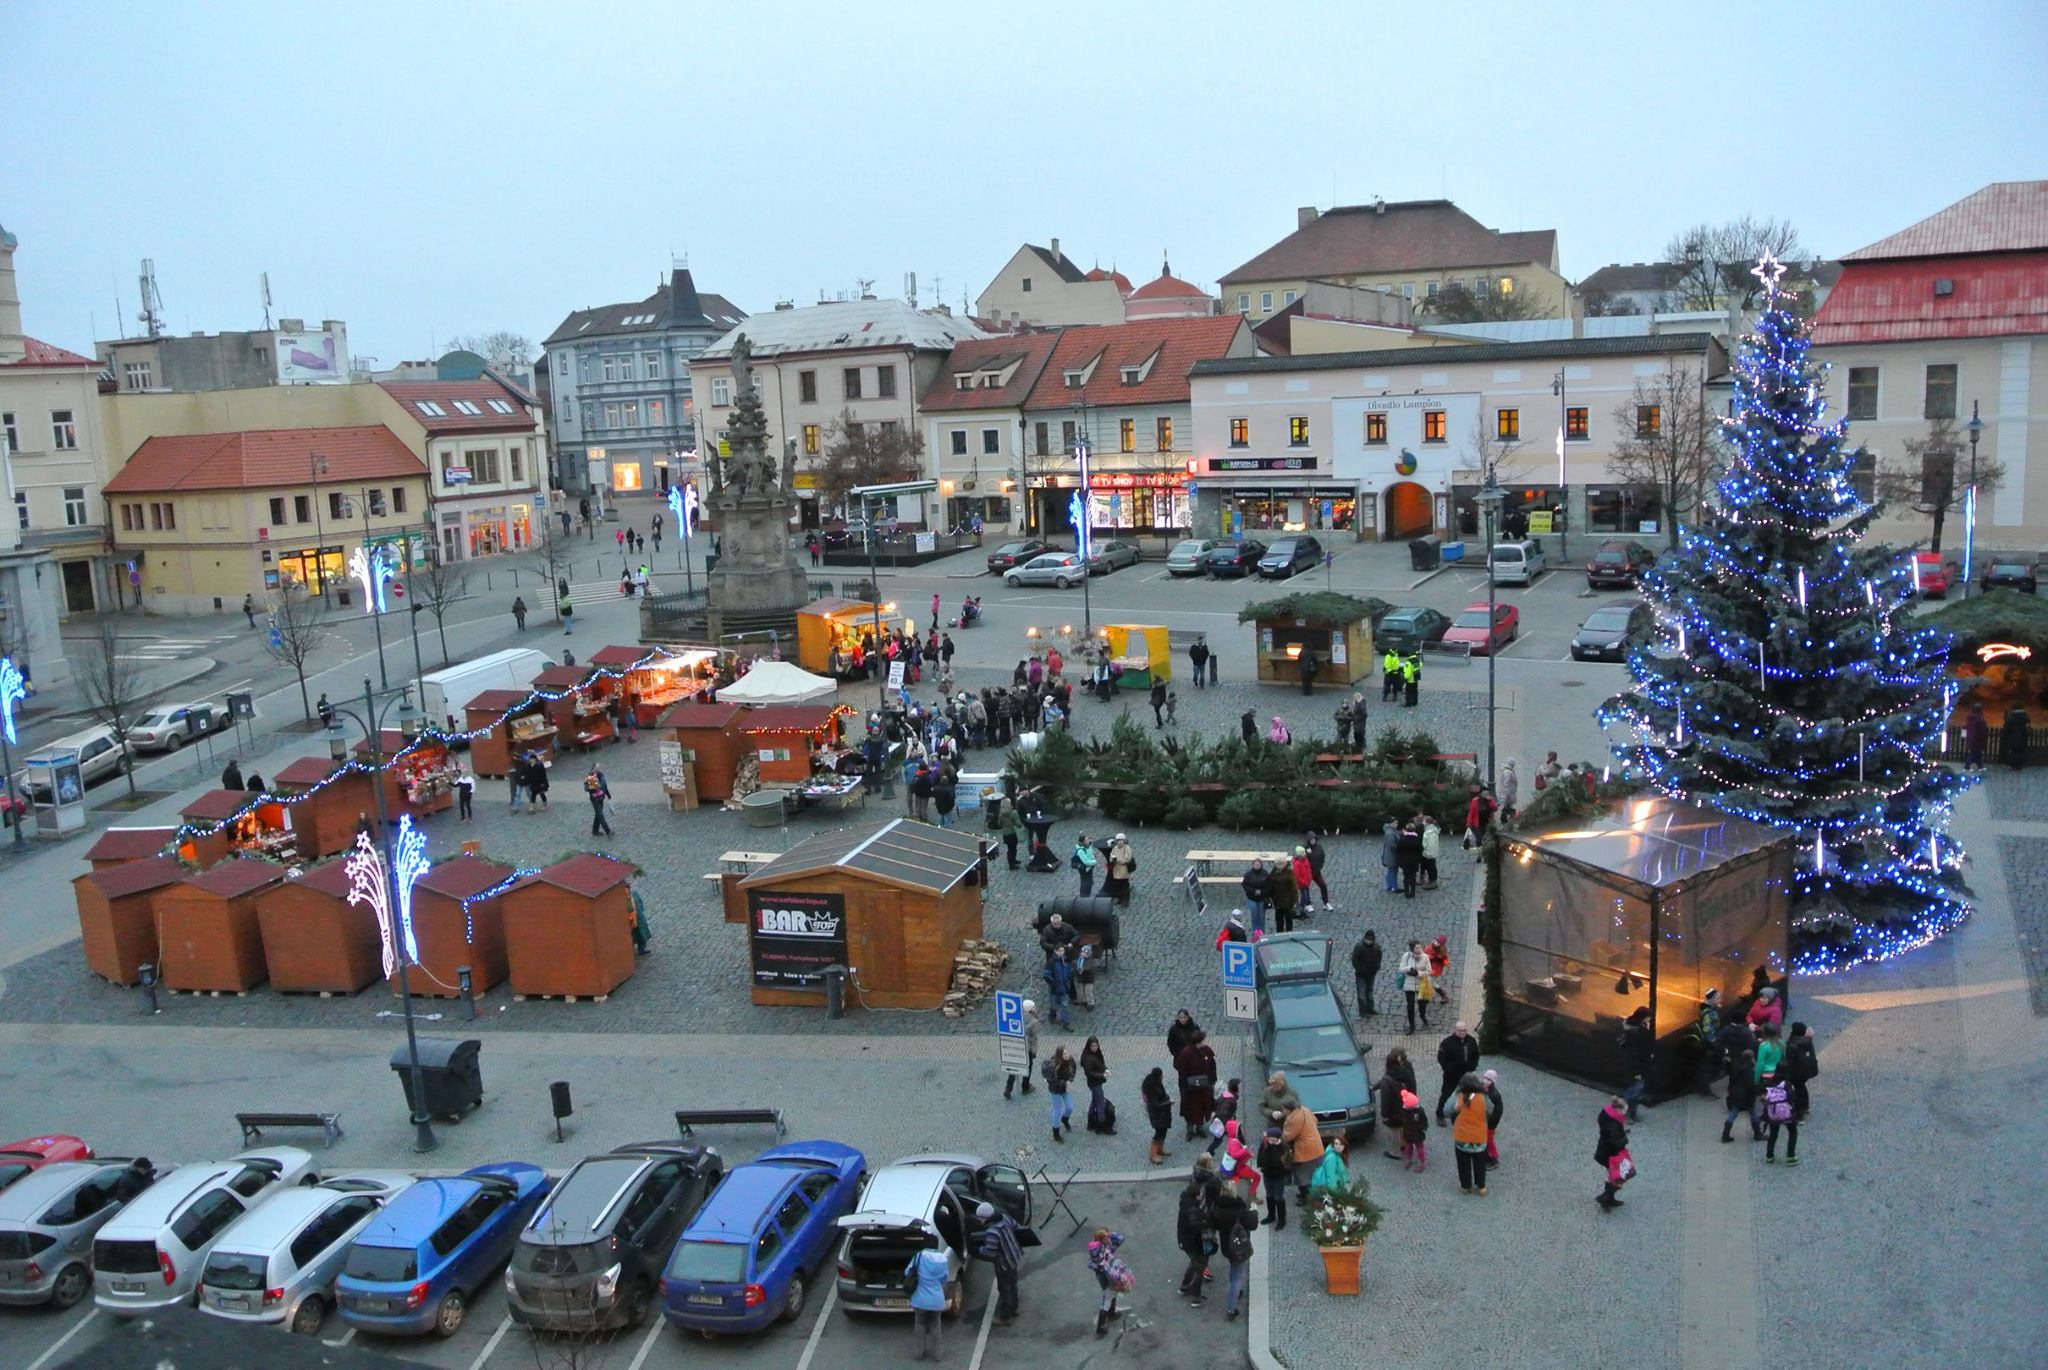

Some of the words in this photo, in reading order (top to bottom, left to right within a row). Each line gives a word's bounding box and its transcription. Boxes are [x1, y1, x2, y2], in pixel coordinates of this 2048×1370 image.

[1368, 400, 1400, 410] Divadlo
[1404, 399, 1442, 409] Lampion
[1113, 477, 1134, 485] SHOP
[1146, 477, 1156, 485] TV
[762, 909, 808, 932] BAR
[813, 921, 835, 931] TOP
[1229, 948, 1248, 974] P
[1001, 997, 1018, 1022] P
